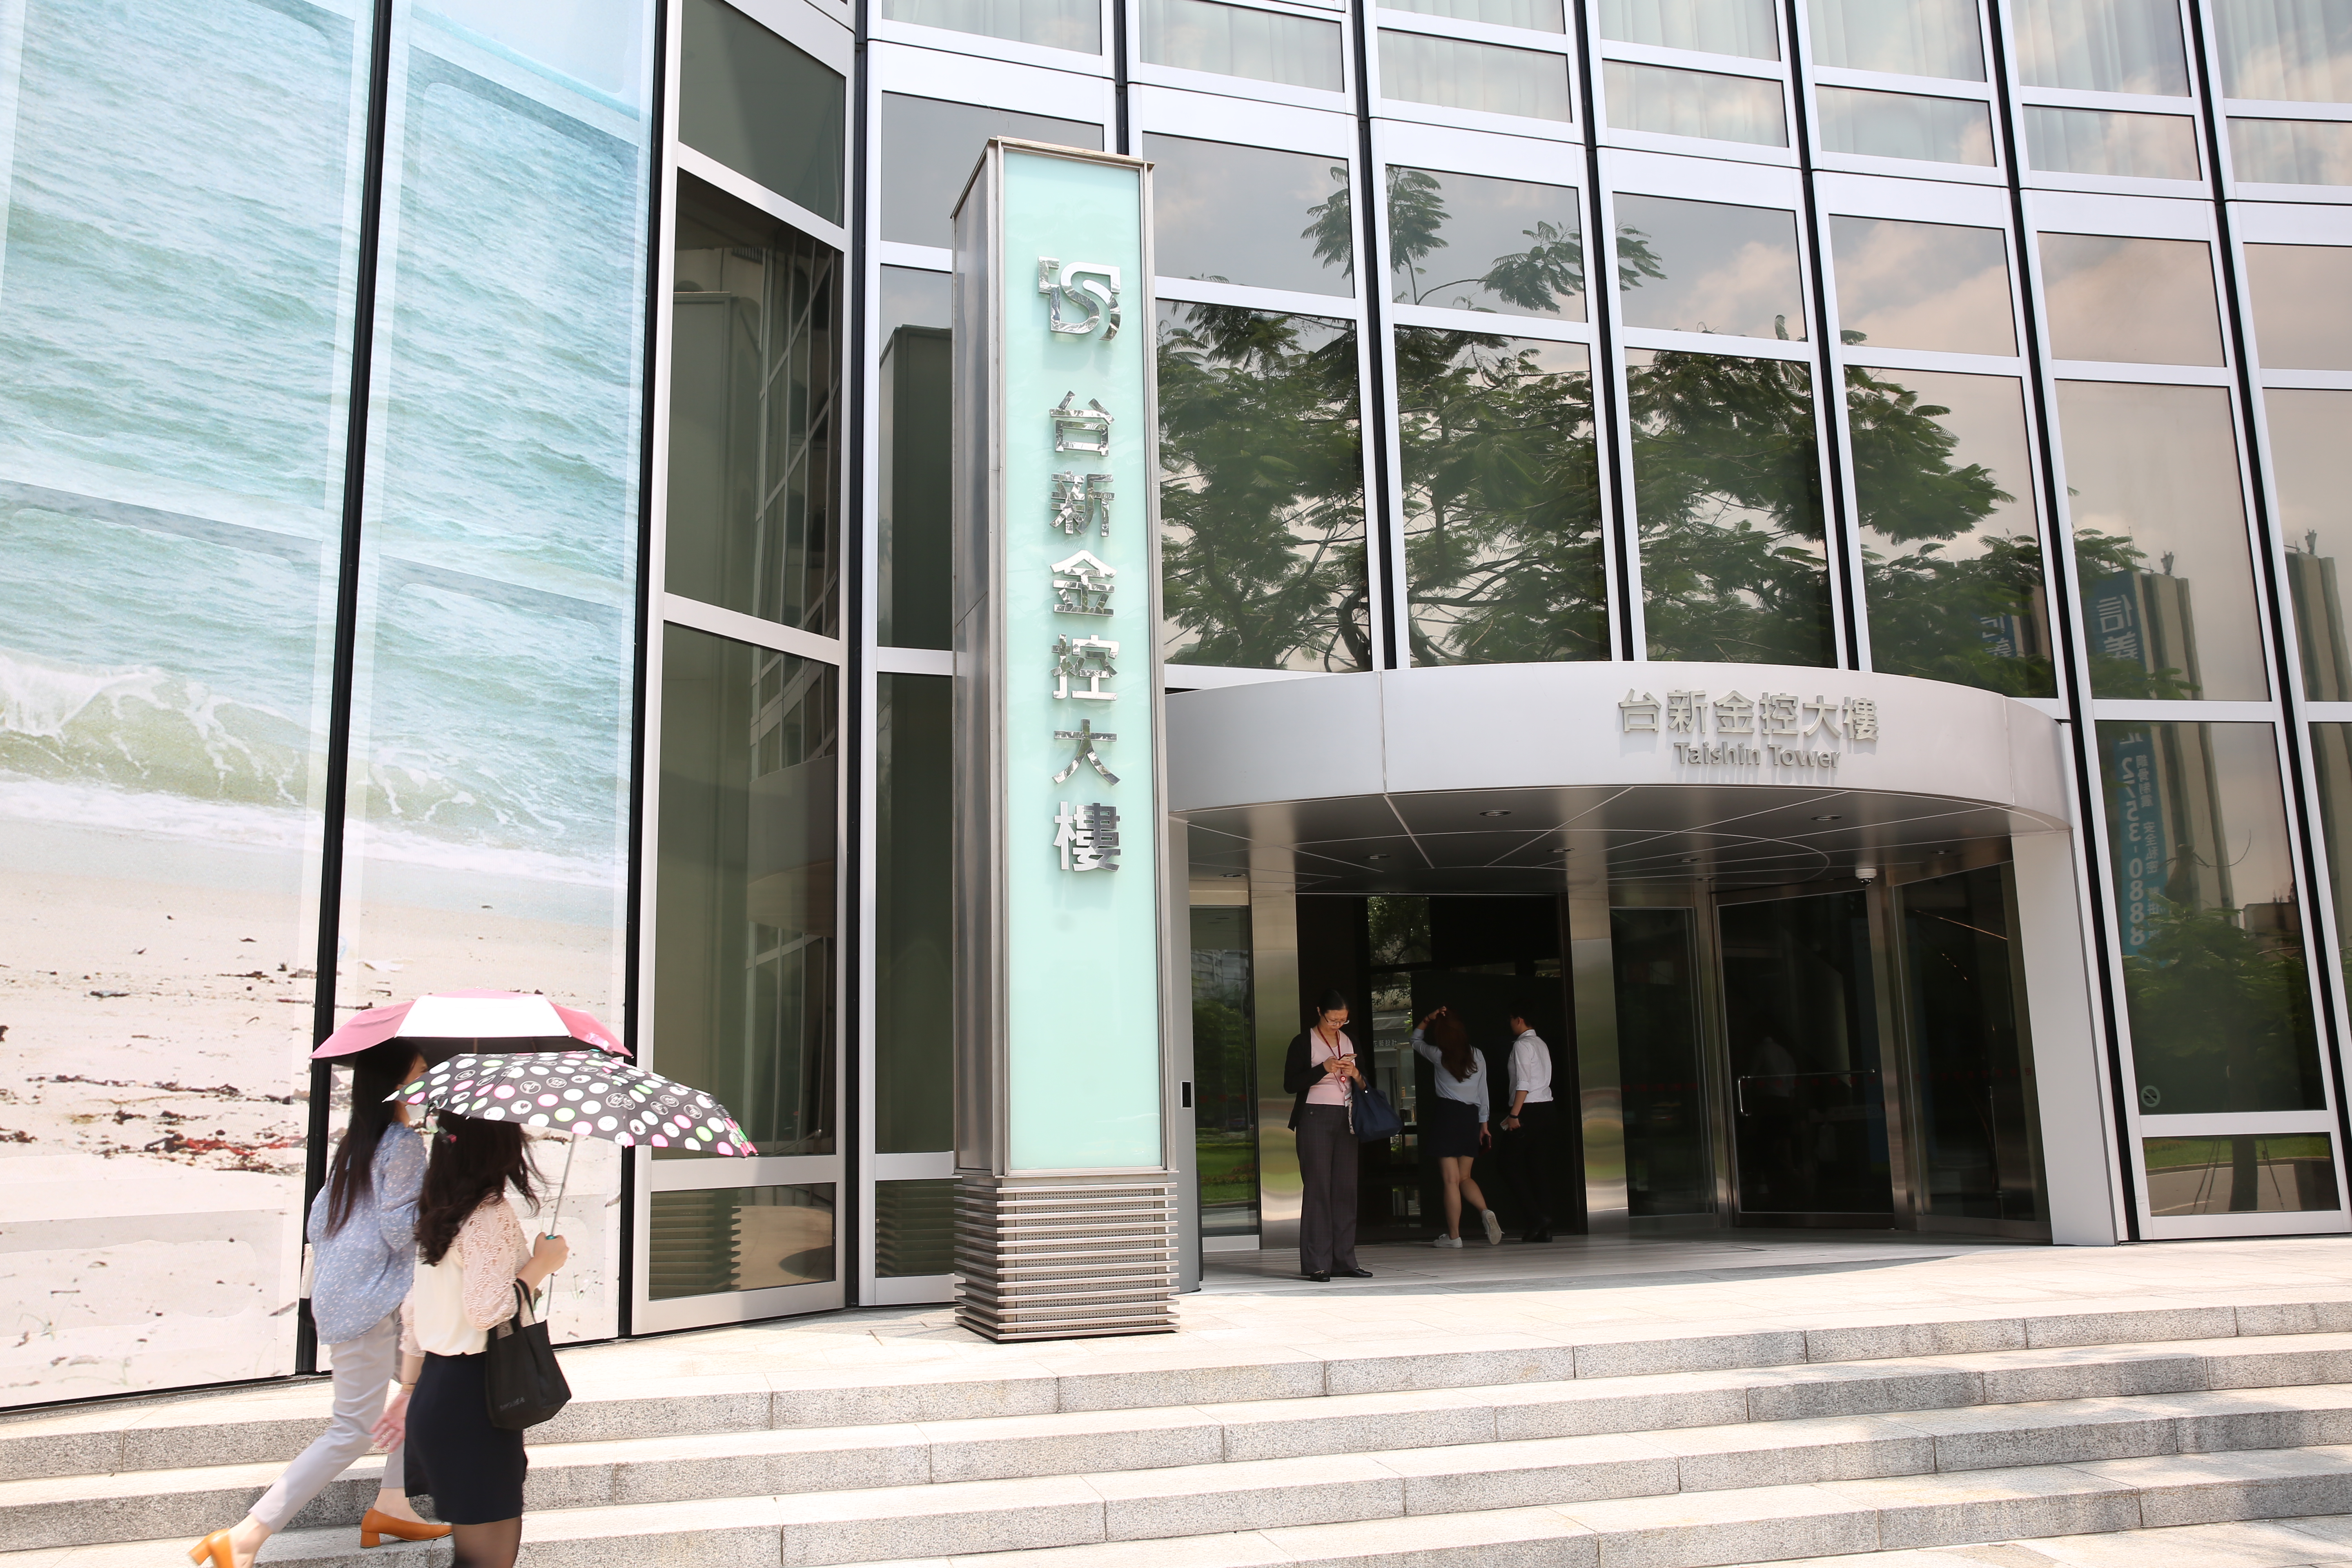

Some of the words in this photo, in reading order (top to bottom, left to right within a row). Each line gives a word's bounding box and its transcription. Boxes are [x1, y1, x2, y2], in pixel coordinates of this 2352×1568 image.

[1049, 390, 1122, 873] 台新金控大樓
[1618, 688, 1879, 742] 台新金控大樓
[1674, 741, 1761, 766] Taishin
[1767, 744, 1841, 768] Tower
